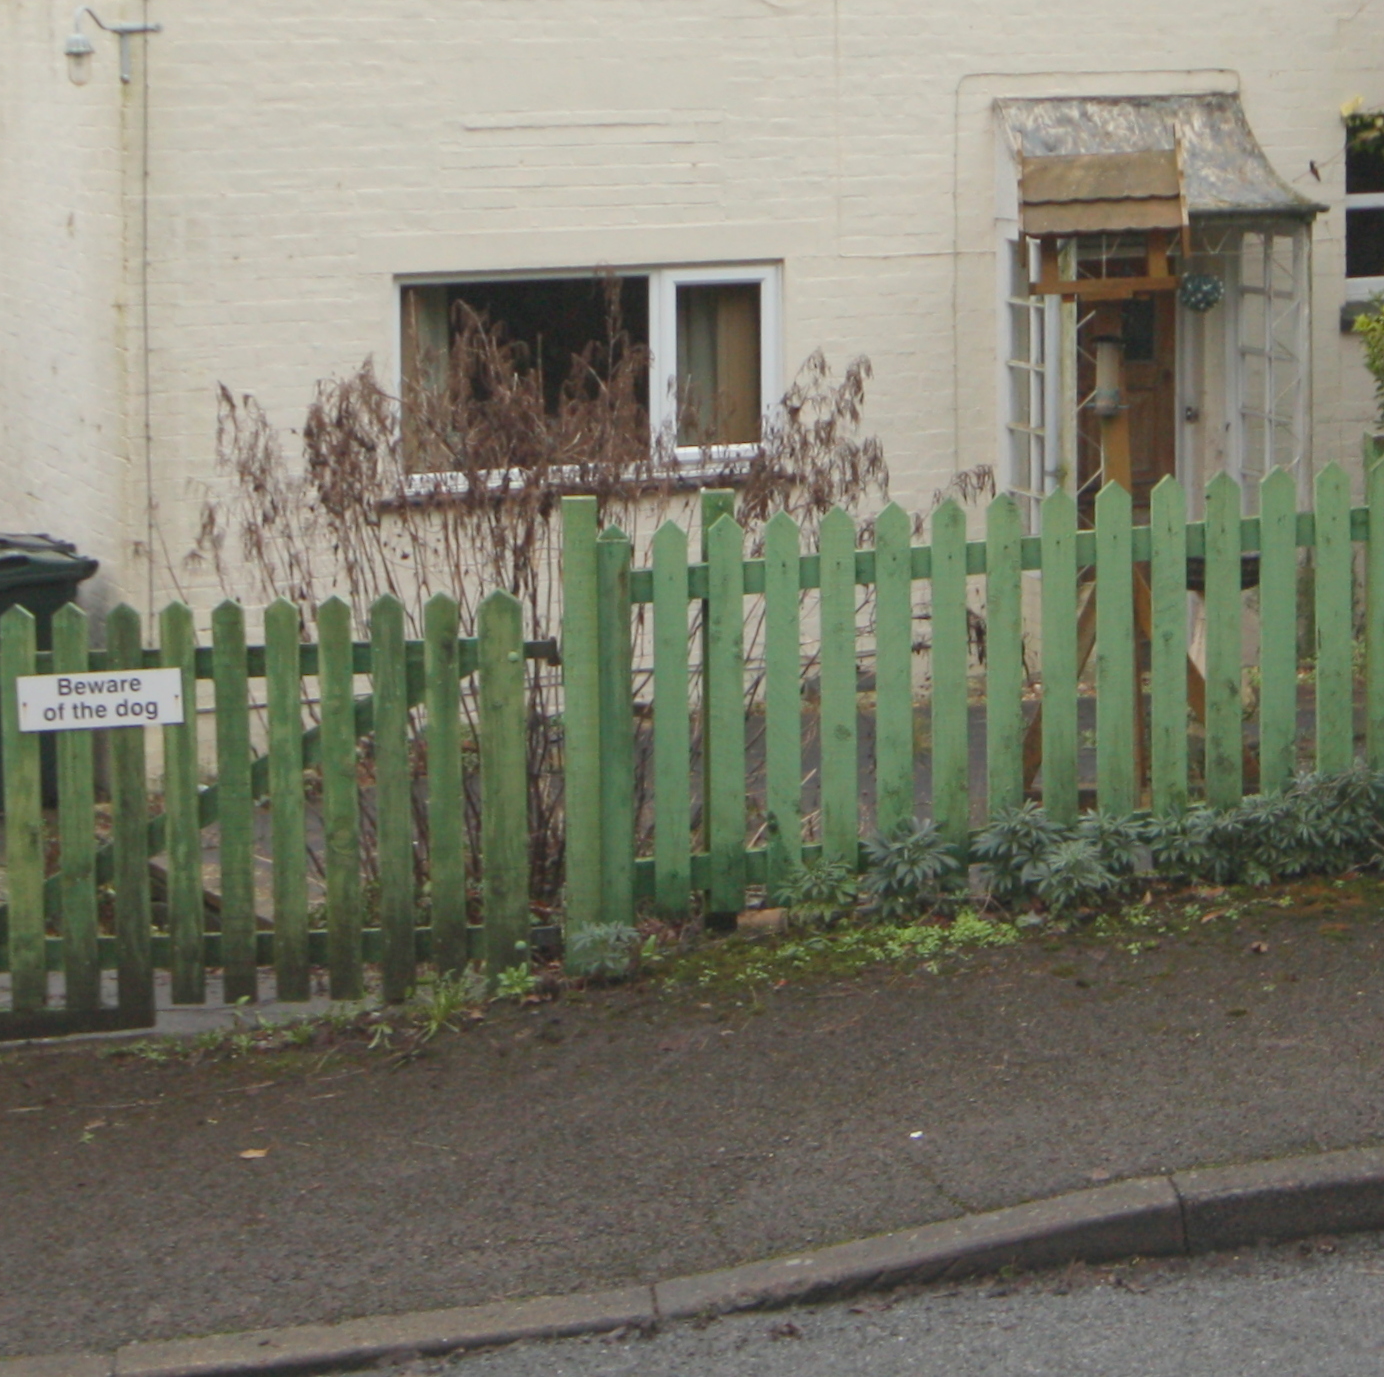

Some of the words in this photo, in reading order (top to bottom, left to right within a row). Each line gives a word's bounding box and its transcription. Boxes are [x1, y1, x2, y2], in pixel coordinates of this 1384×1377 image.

[58, 677, 142, 697] Beware
[43, 702, 66, 722] of
[72, 700, 108, 720] the
[115, 698, 159, 721] dog
